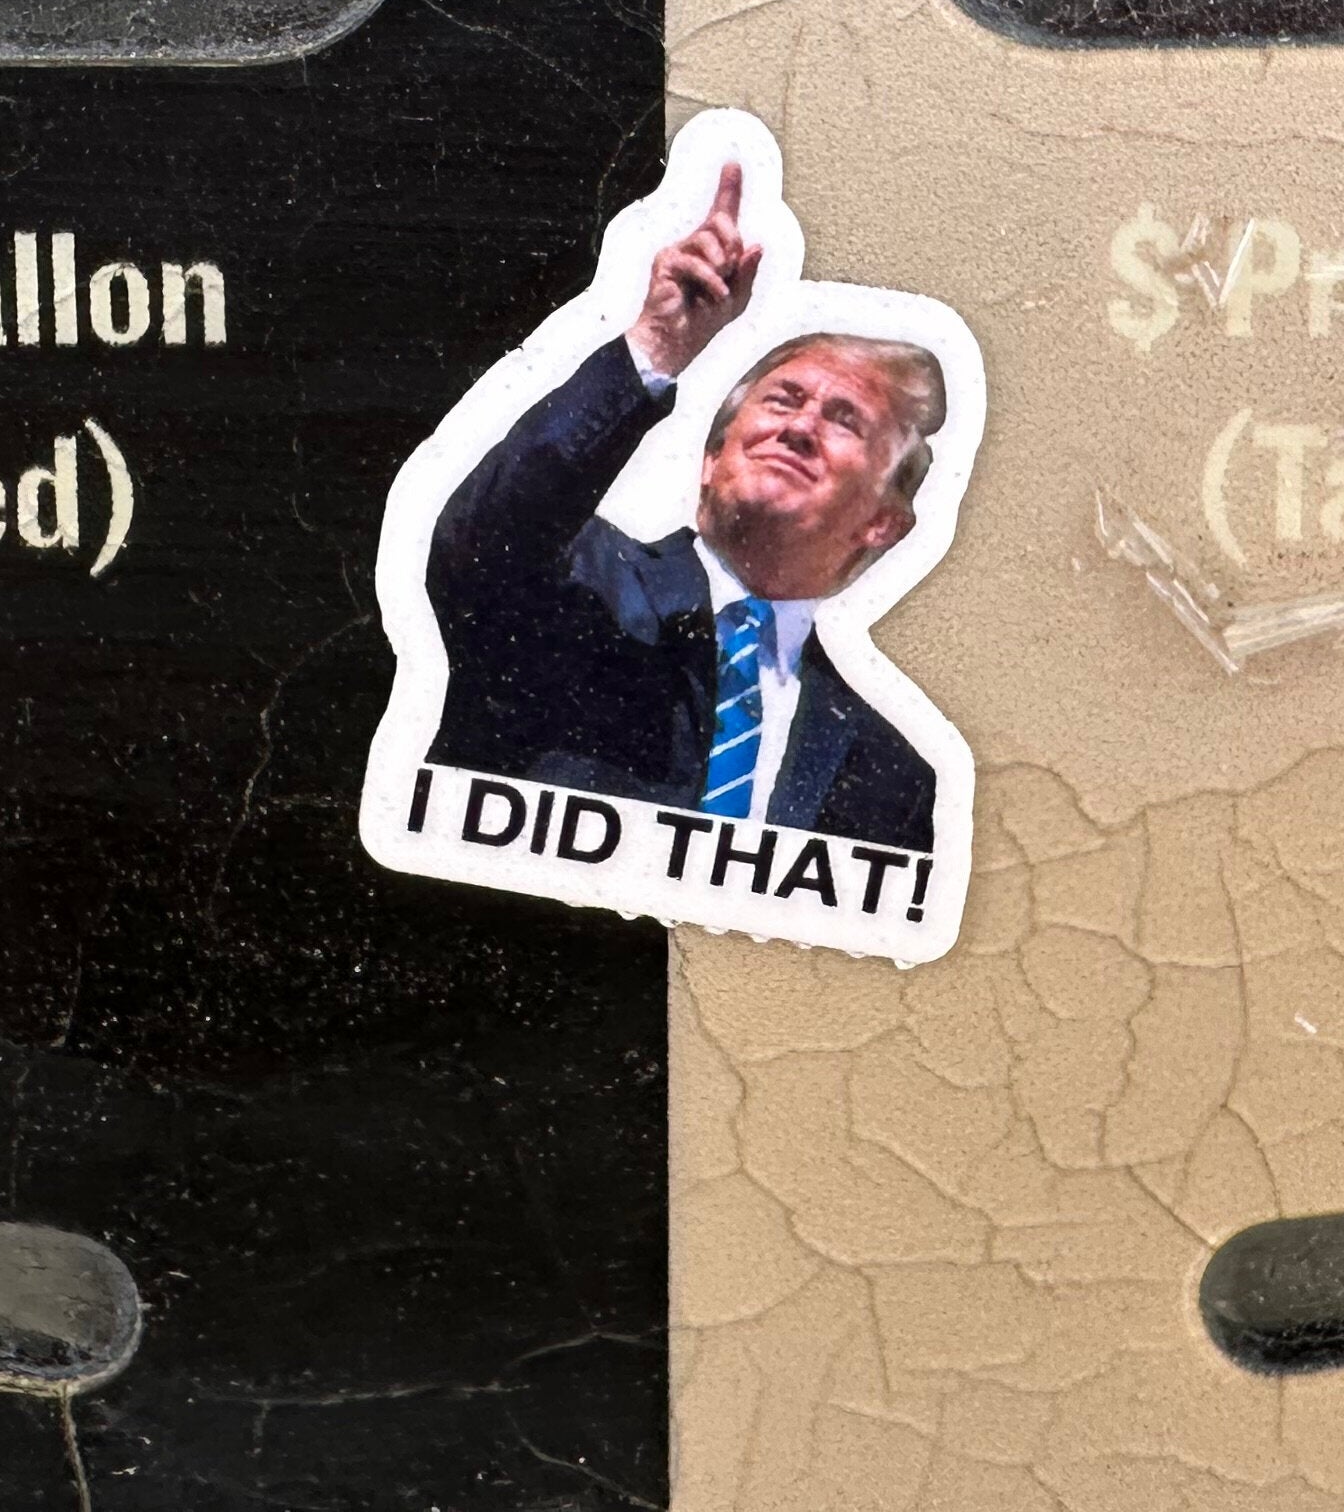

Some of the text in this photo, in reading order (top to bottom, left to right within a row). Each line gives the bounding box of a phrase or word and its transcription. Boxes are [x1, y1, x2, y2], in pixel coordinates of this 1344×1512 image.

[1107, 204, 1181, 355] $
[407, 769, 933, 923] I DID THAT!
